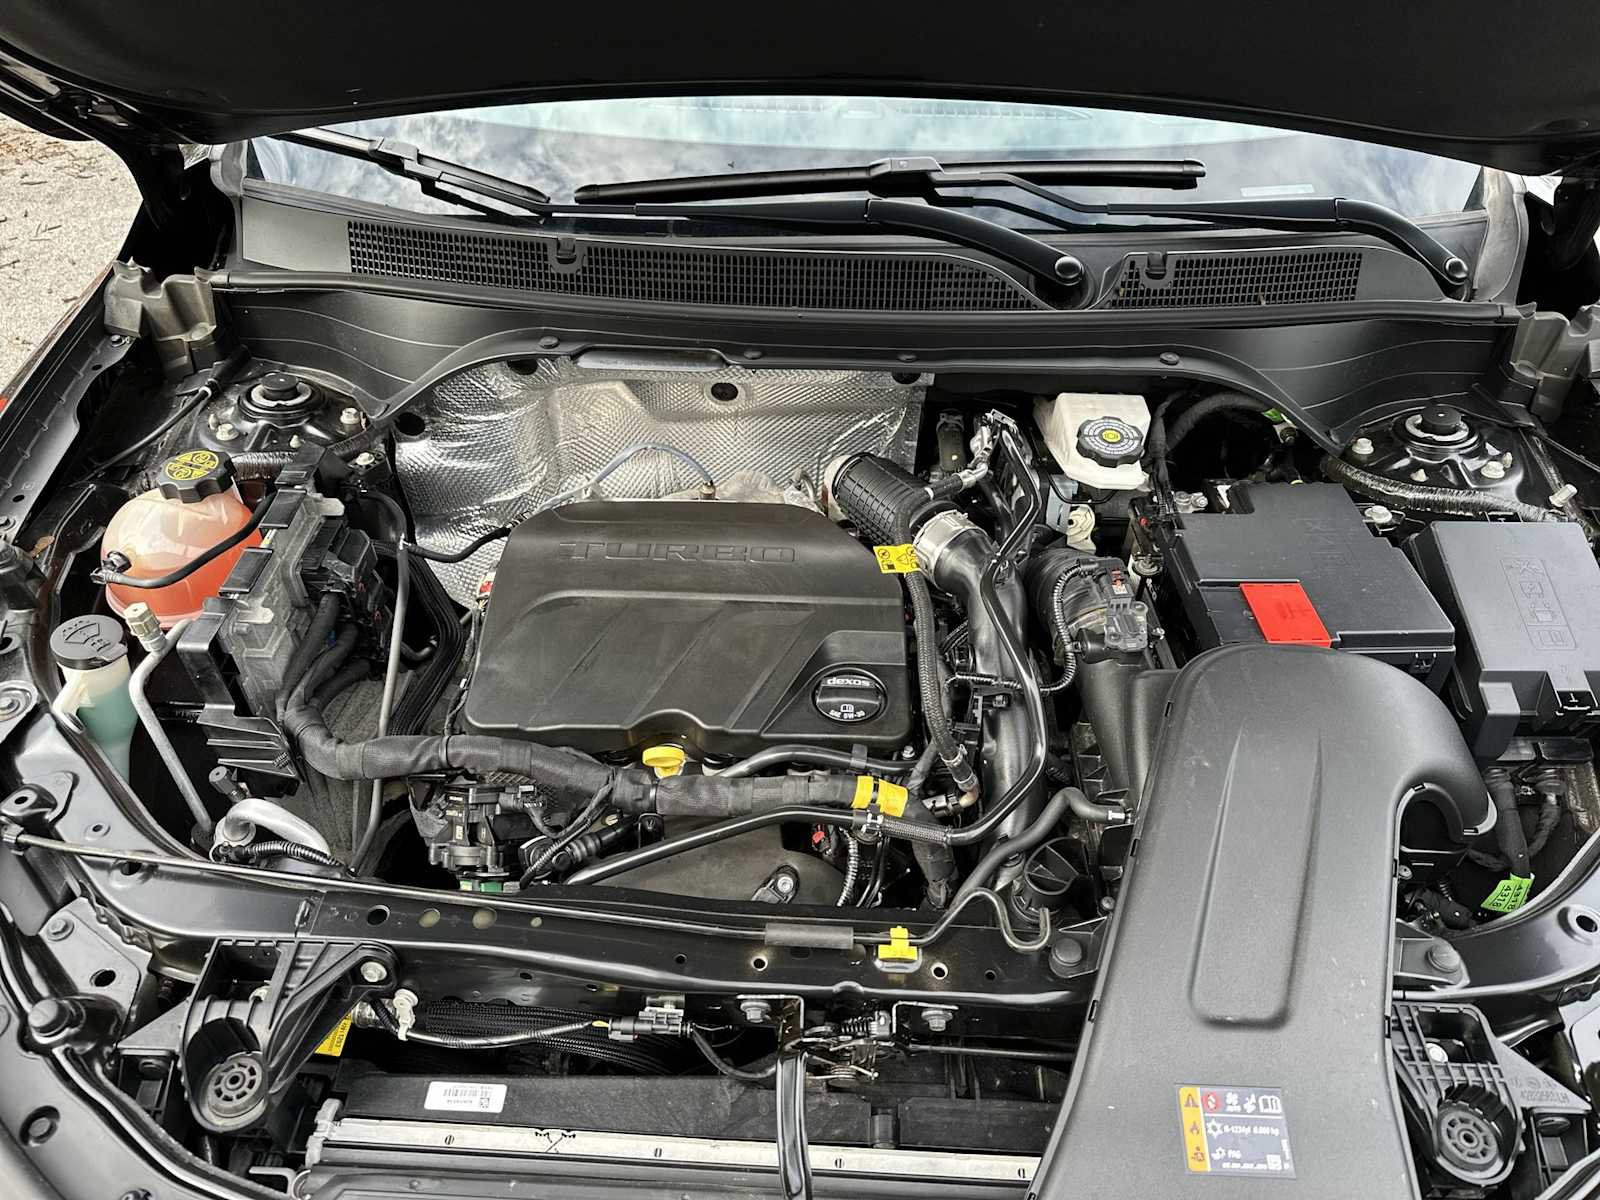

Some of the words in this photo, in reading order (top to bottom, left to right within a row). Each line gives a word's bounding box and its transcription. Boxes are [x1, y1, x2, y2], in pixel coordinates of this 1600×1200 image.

[559, 542, 797, 562] TURBO
[827, 677, 870, 686] dexos
[1492, 885, 1511, 908] 4318
